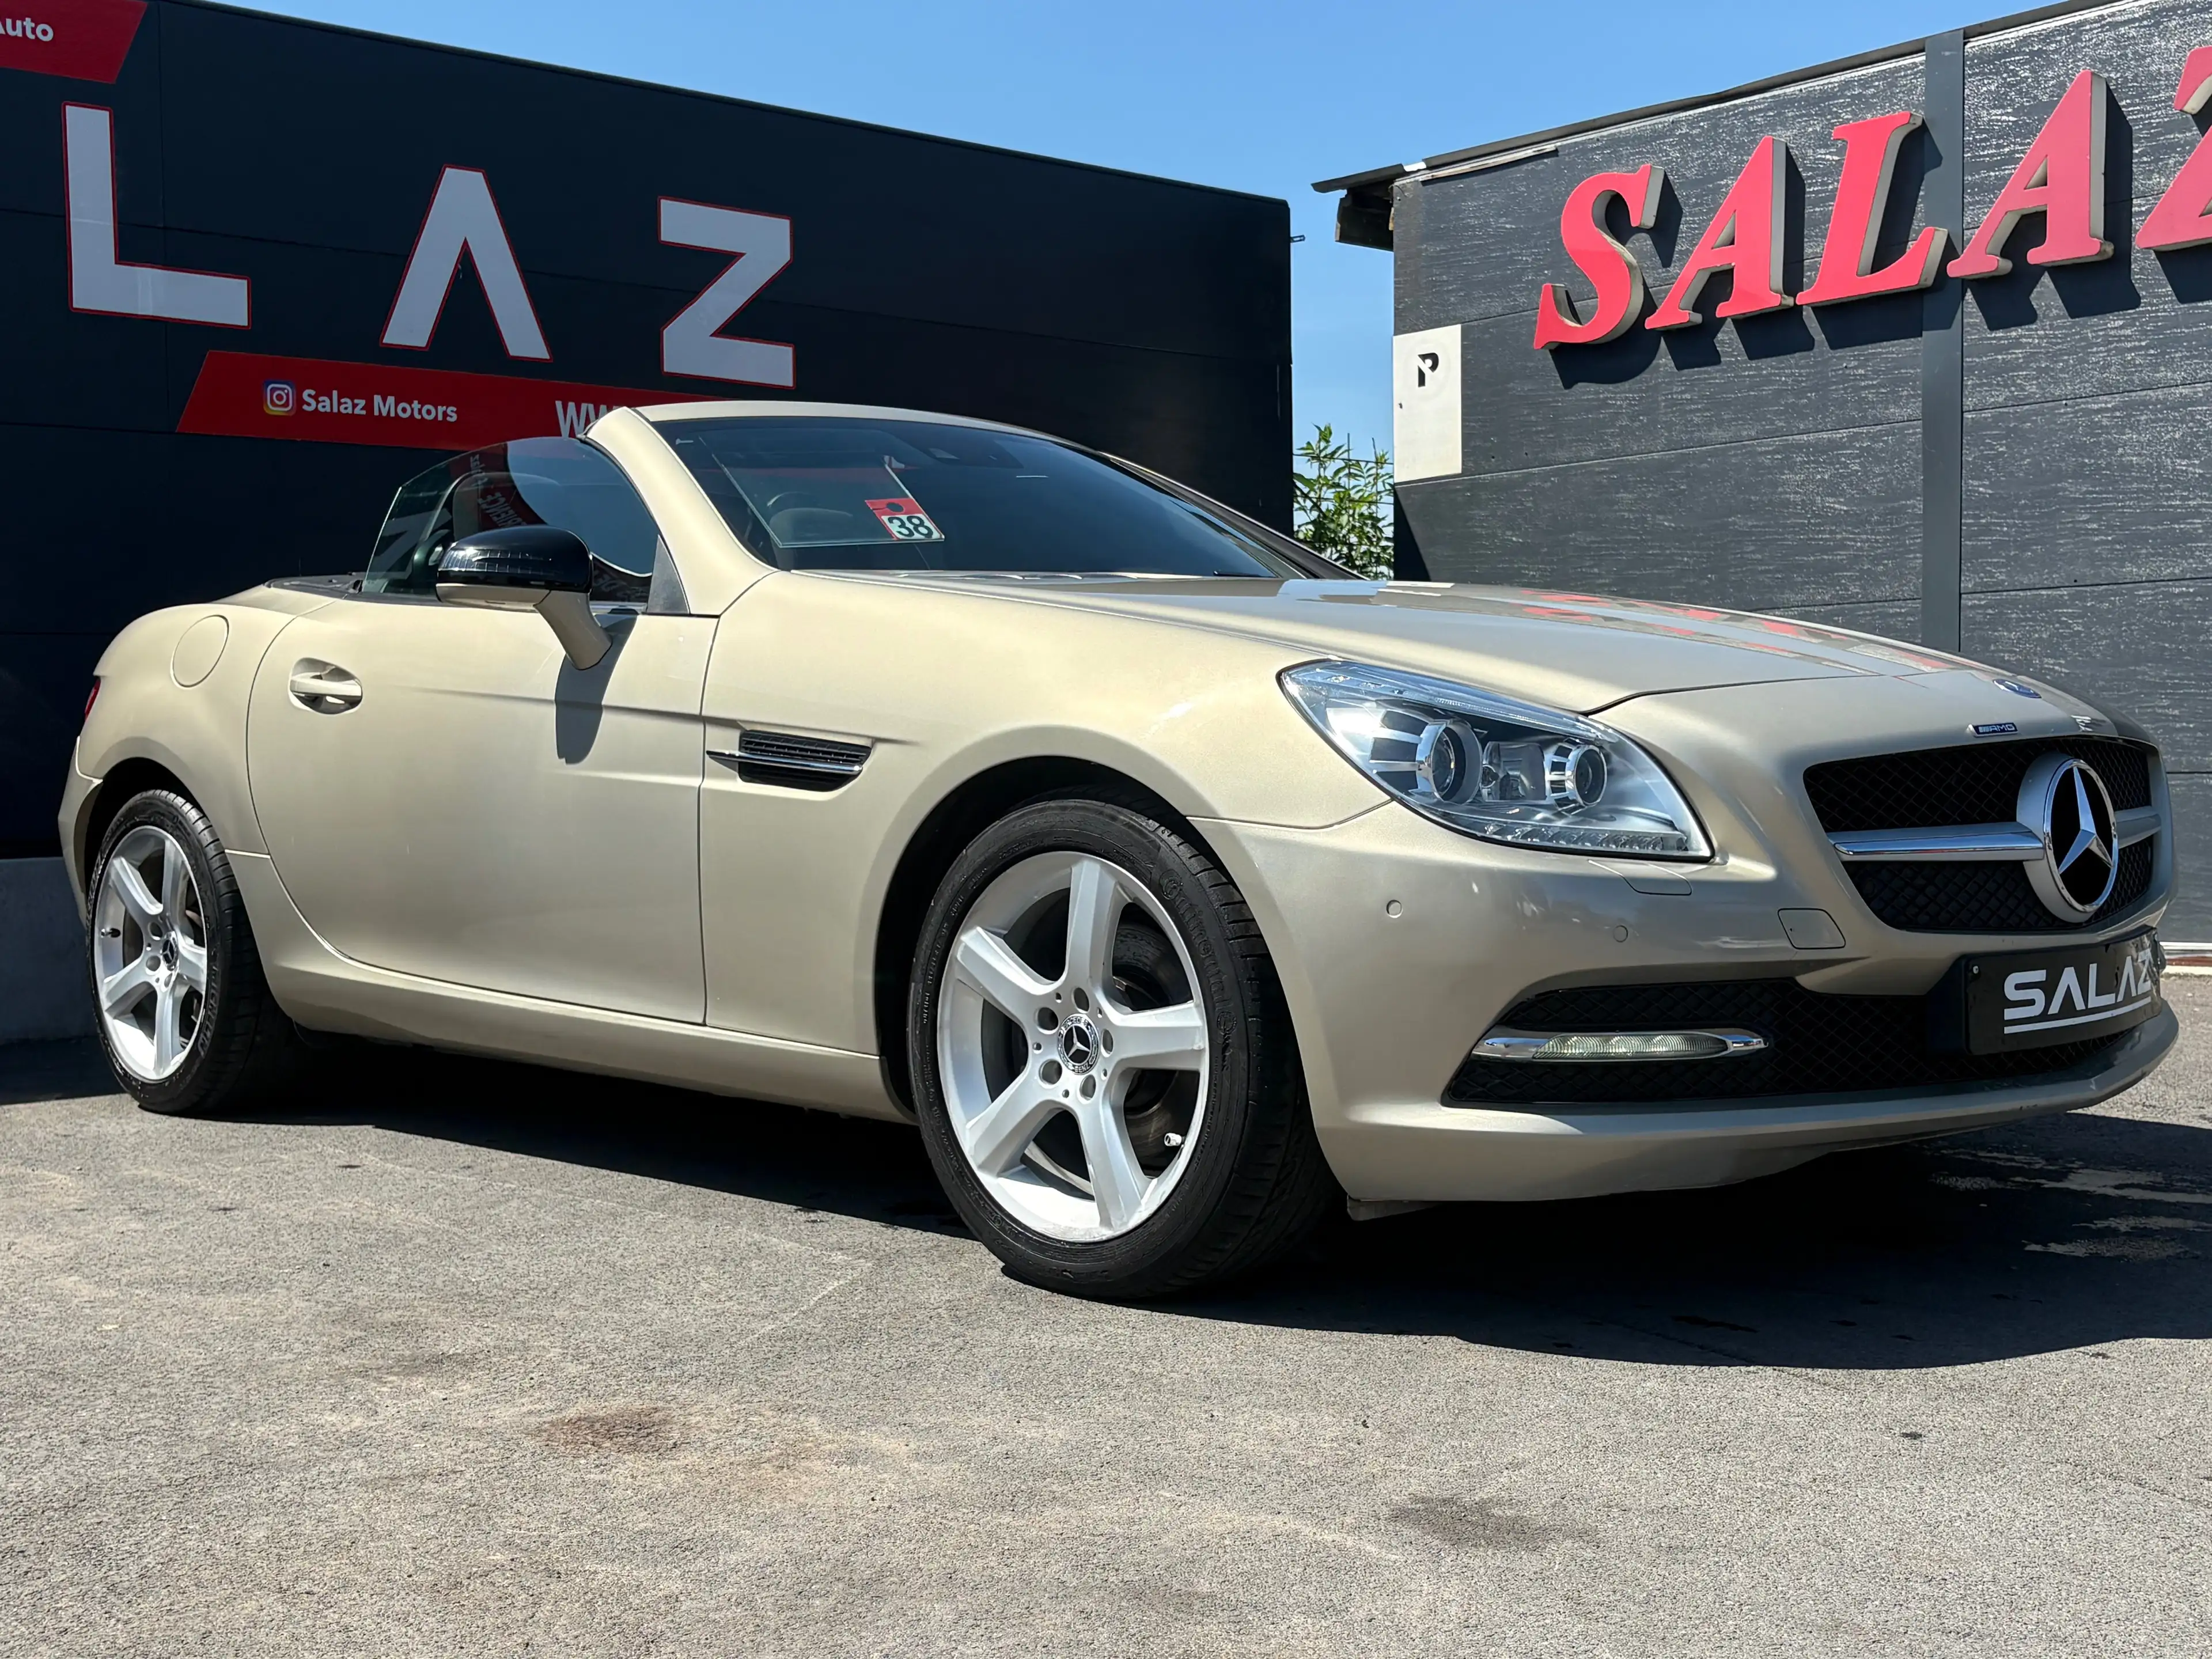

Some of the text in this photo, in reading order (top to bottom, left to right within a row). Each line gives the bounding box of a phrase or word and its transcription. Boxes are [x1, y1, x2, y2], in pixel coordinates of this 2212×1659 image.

[0, 17, 54, 41] uto
[1417, 352, 1440, 388] P
[302, 389, 458, 422] Salaz Motors
[888, 516, 933, 539] 38
[2004, 948, 2152, 1020] SALAZ
